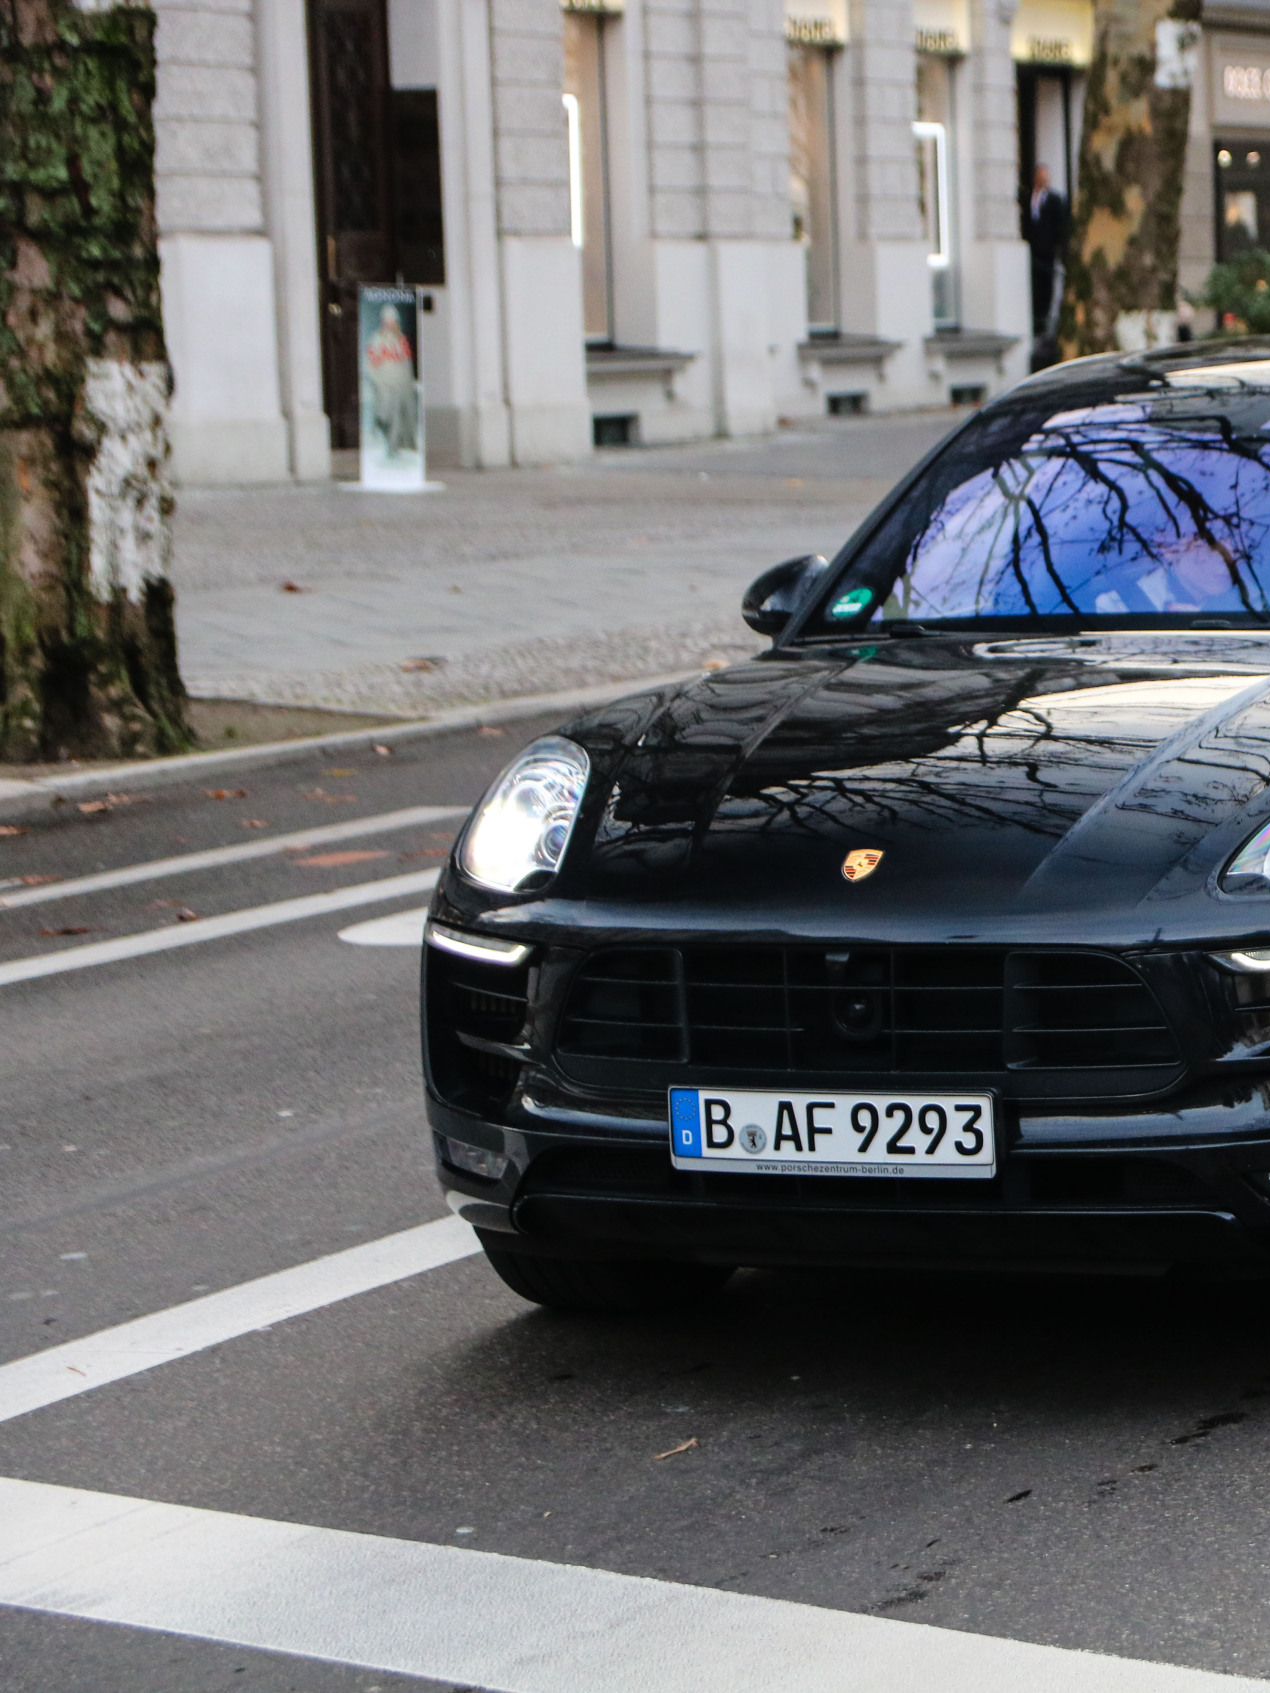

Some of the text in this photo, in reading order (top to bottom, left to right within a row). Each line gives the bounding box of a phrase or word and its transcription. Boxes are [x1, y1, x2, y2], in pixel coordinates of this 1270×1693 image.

[704, 1098, 735, 1149] B
[773, 1100, 836, 1152] AF
[850, 1101, 984, 1156] 9293
[681, 1129, 693, 1146] D
[756, 1162, 905, 1176] www.porschezentrum-berlin.de
